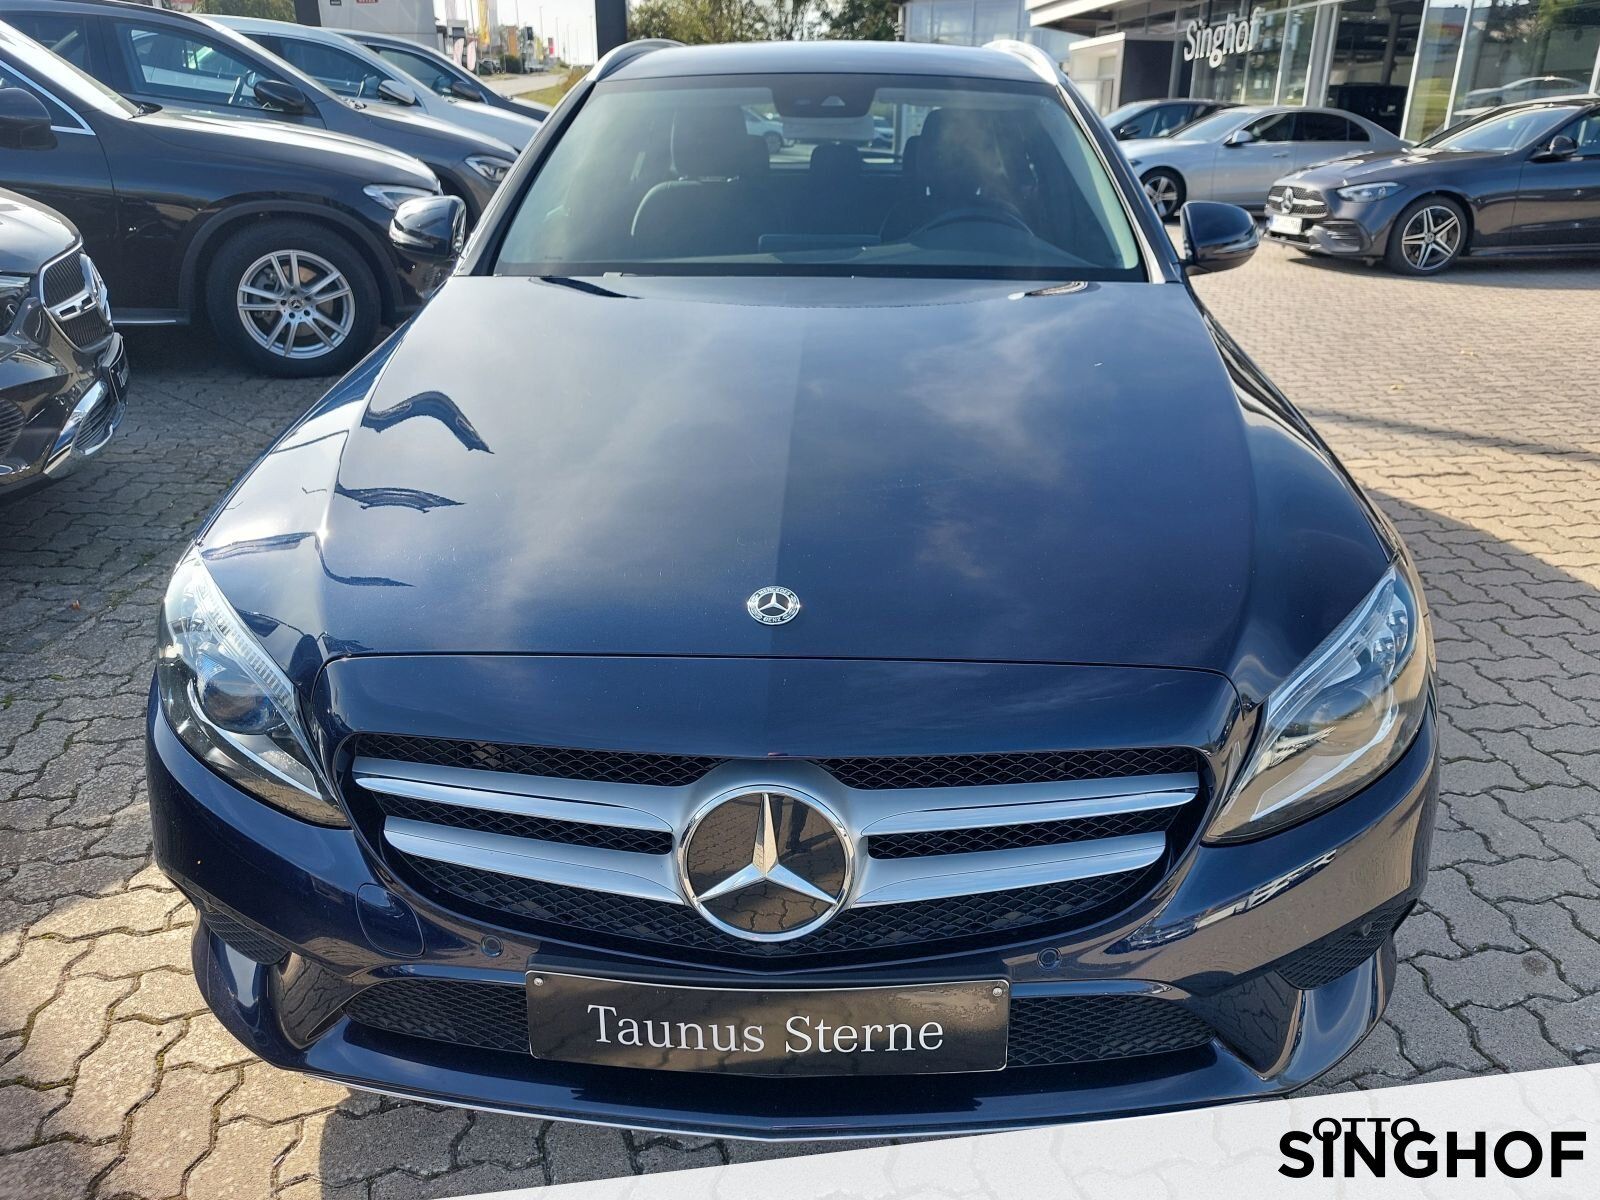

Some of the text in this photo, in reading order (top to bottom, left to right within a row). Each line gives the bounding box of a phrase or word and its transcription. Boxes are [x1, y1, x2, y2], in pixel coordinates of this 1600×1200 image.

[1184, 7, 1265, 68] Singhof
[587, 1004, 944, 1053] Taunus Sterne
